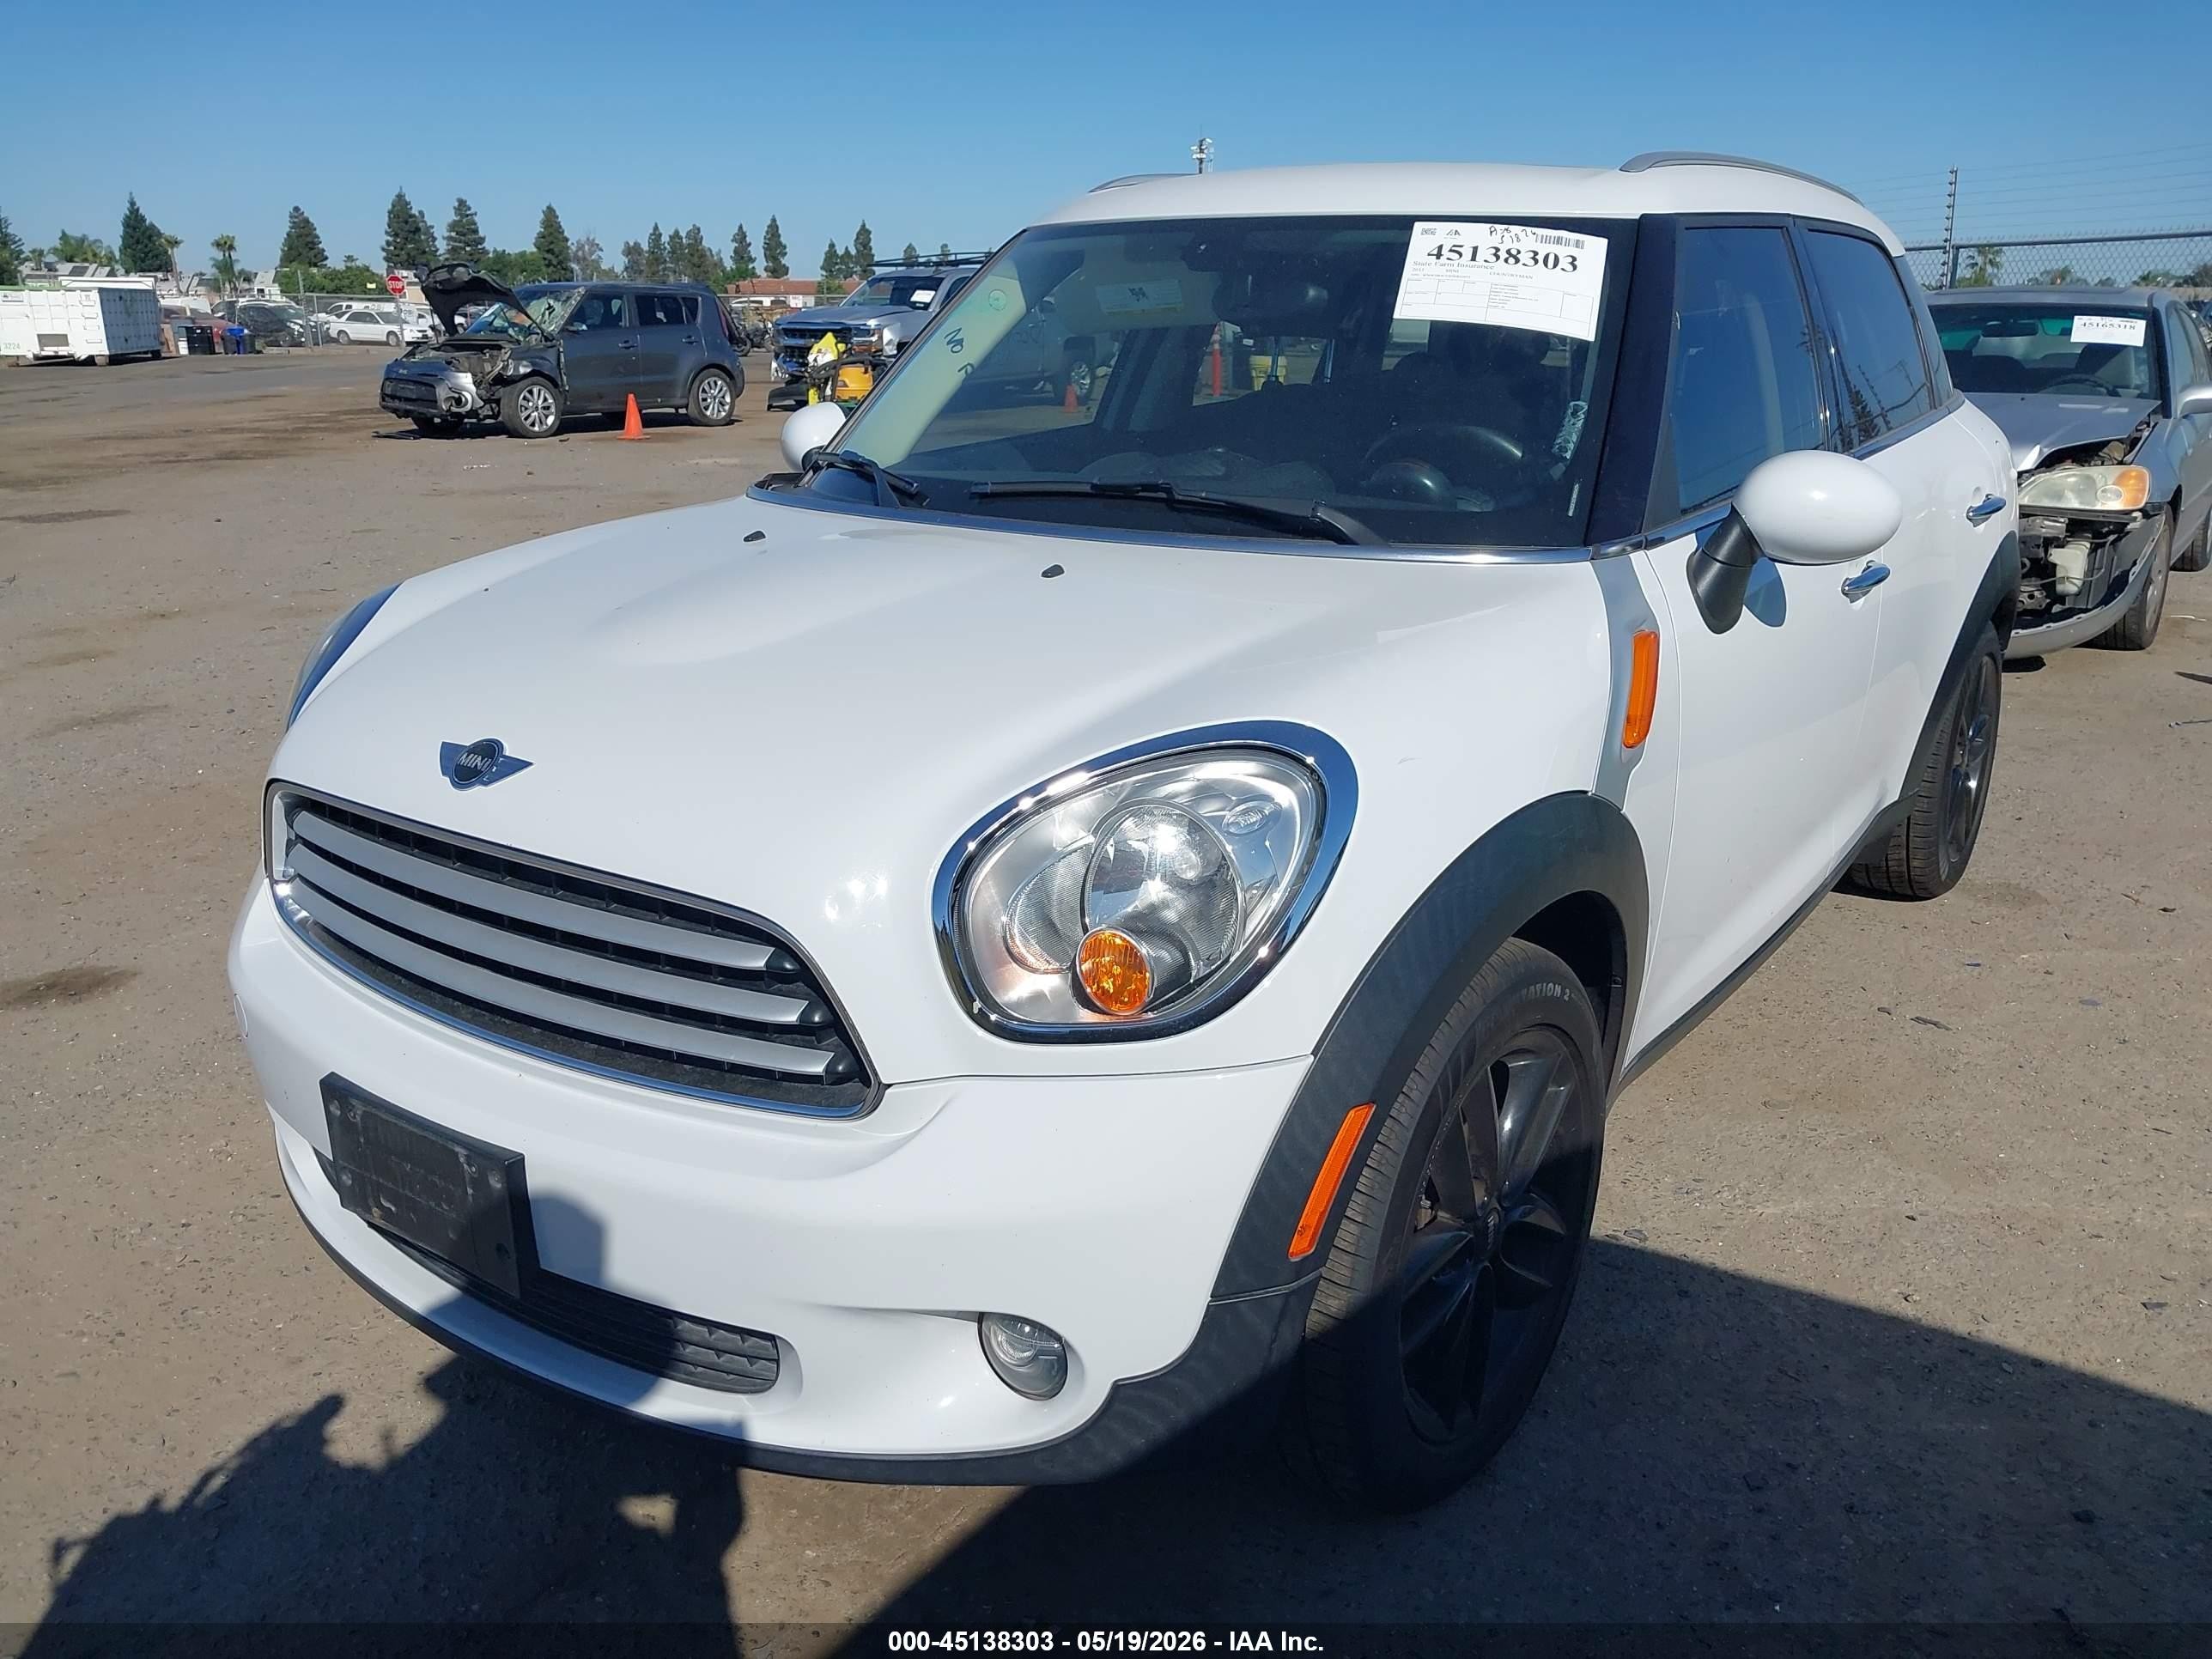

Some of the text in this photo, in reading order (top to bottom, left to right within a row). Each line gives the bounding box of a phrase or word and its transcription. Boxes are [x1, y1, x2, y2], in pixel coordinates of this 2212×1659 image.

[1427, 243, 1578, 273] 45138303
[388, 281, 404, 289] STOP
[458, 752, 493, 772] MINI
